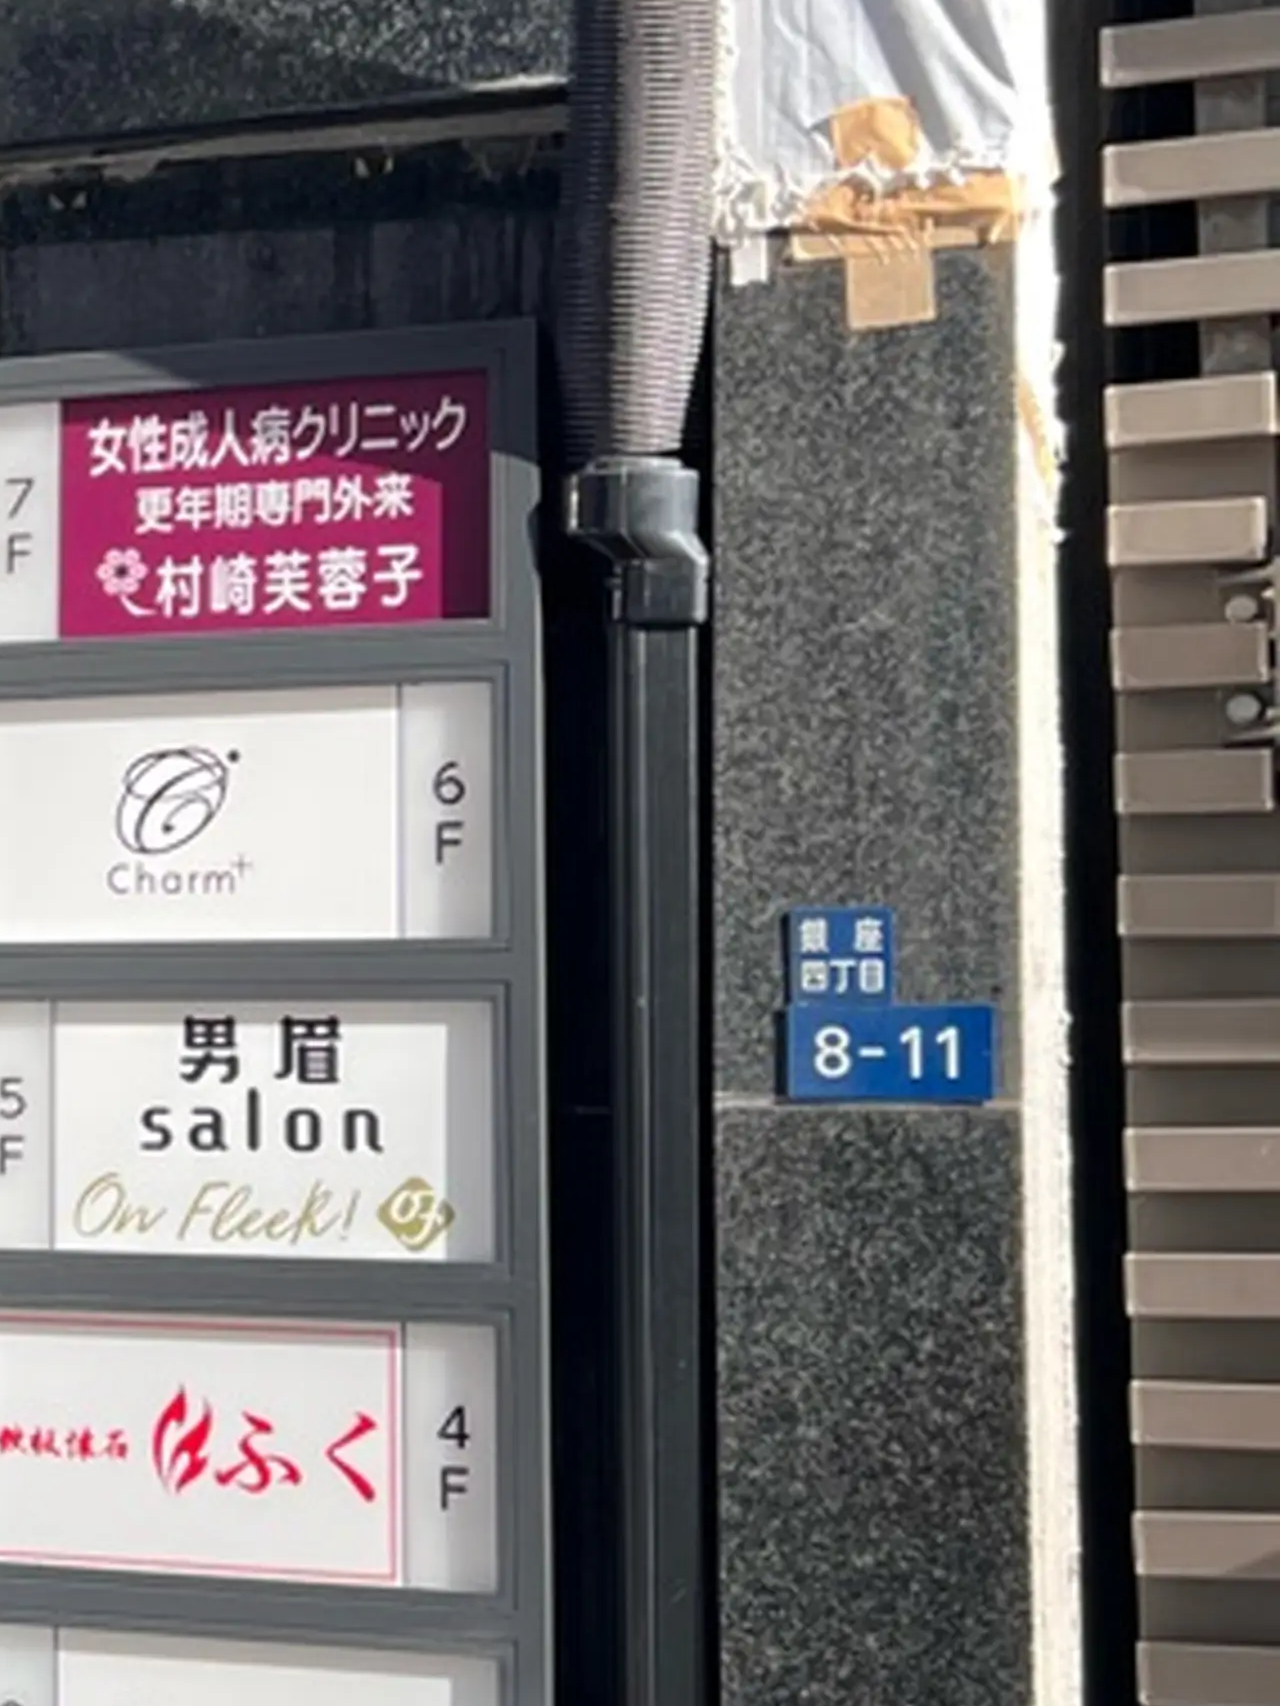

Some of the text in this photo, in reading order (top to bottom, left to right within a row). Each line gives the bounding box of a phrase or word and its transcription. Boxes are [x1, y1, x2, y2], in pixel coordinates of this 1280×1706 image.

[87, 396, 468, 477] 女性成人病クリニック
[135, 473, 416, 535] 更年期専門外来
[800, 958, 885, 994] 四丁目
[813, 1026, 960, 1080] 8-11
[140, 1089, 384, 1153] salon
